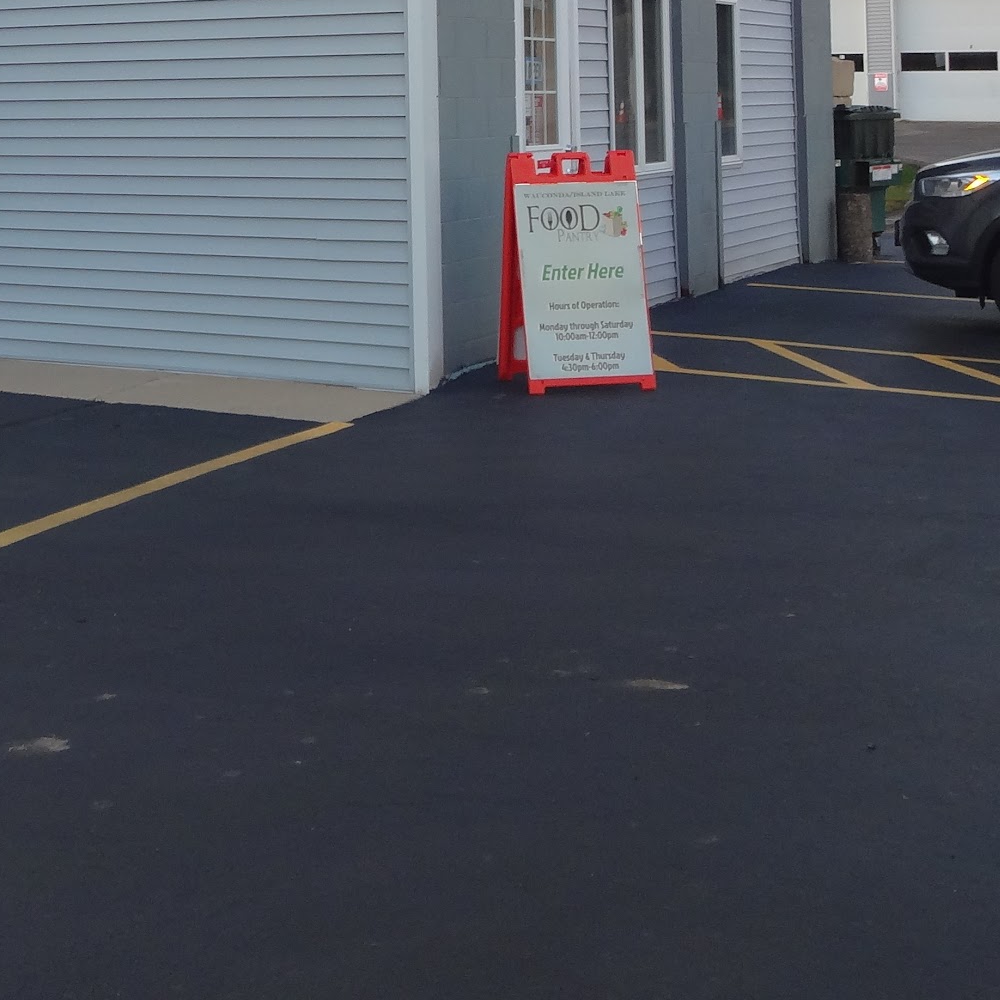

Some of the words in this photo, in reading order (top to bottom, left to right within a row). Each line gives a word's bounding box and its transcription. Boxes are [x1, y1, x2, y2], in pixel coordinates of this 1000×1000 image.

[526, 204, 600, 233] FOOD
[542, 264, 585, 281] Enter
[587, 262, 624, 279] Here
[548, 302, 571, 311] Hours
[571, 301, 580, 310] of
[580, 300, 620, 311] Operation:
[539, 322, 568, 332] Monday
[569, 321, 600, 331] through
[600, 320, 634, 329] Saturday
[555, 331, 619, 341] 10:00am-12:00pm
[553, 352, 584, 362] Tuesday
[585, 352, 590, 361] &
[590, 351, 626, 361] Thursday
[561, 362, 620, 372] 4:30pm-6:00pm
